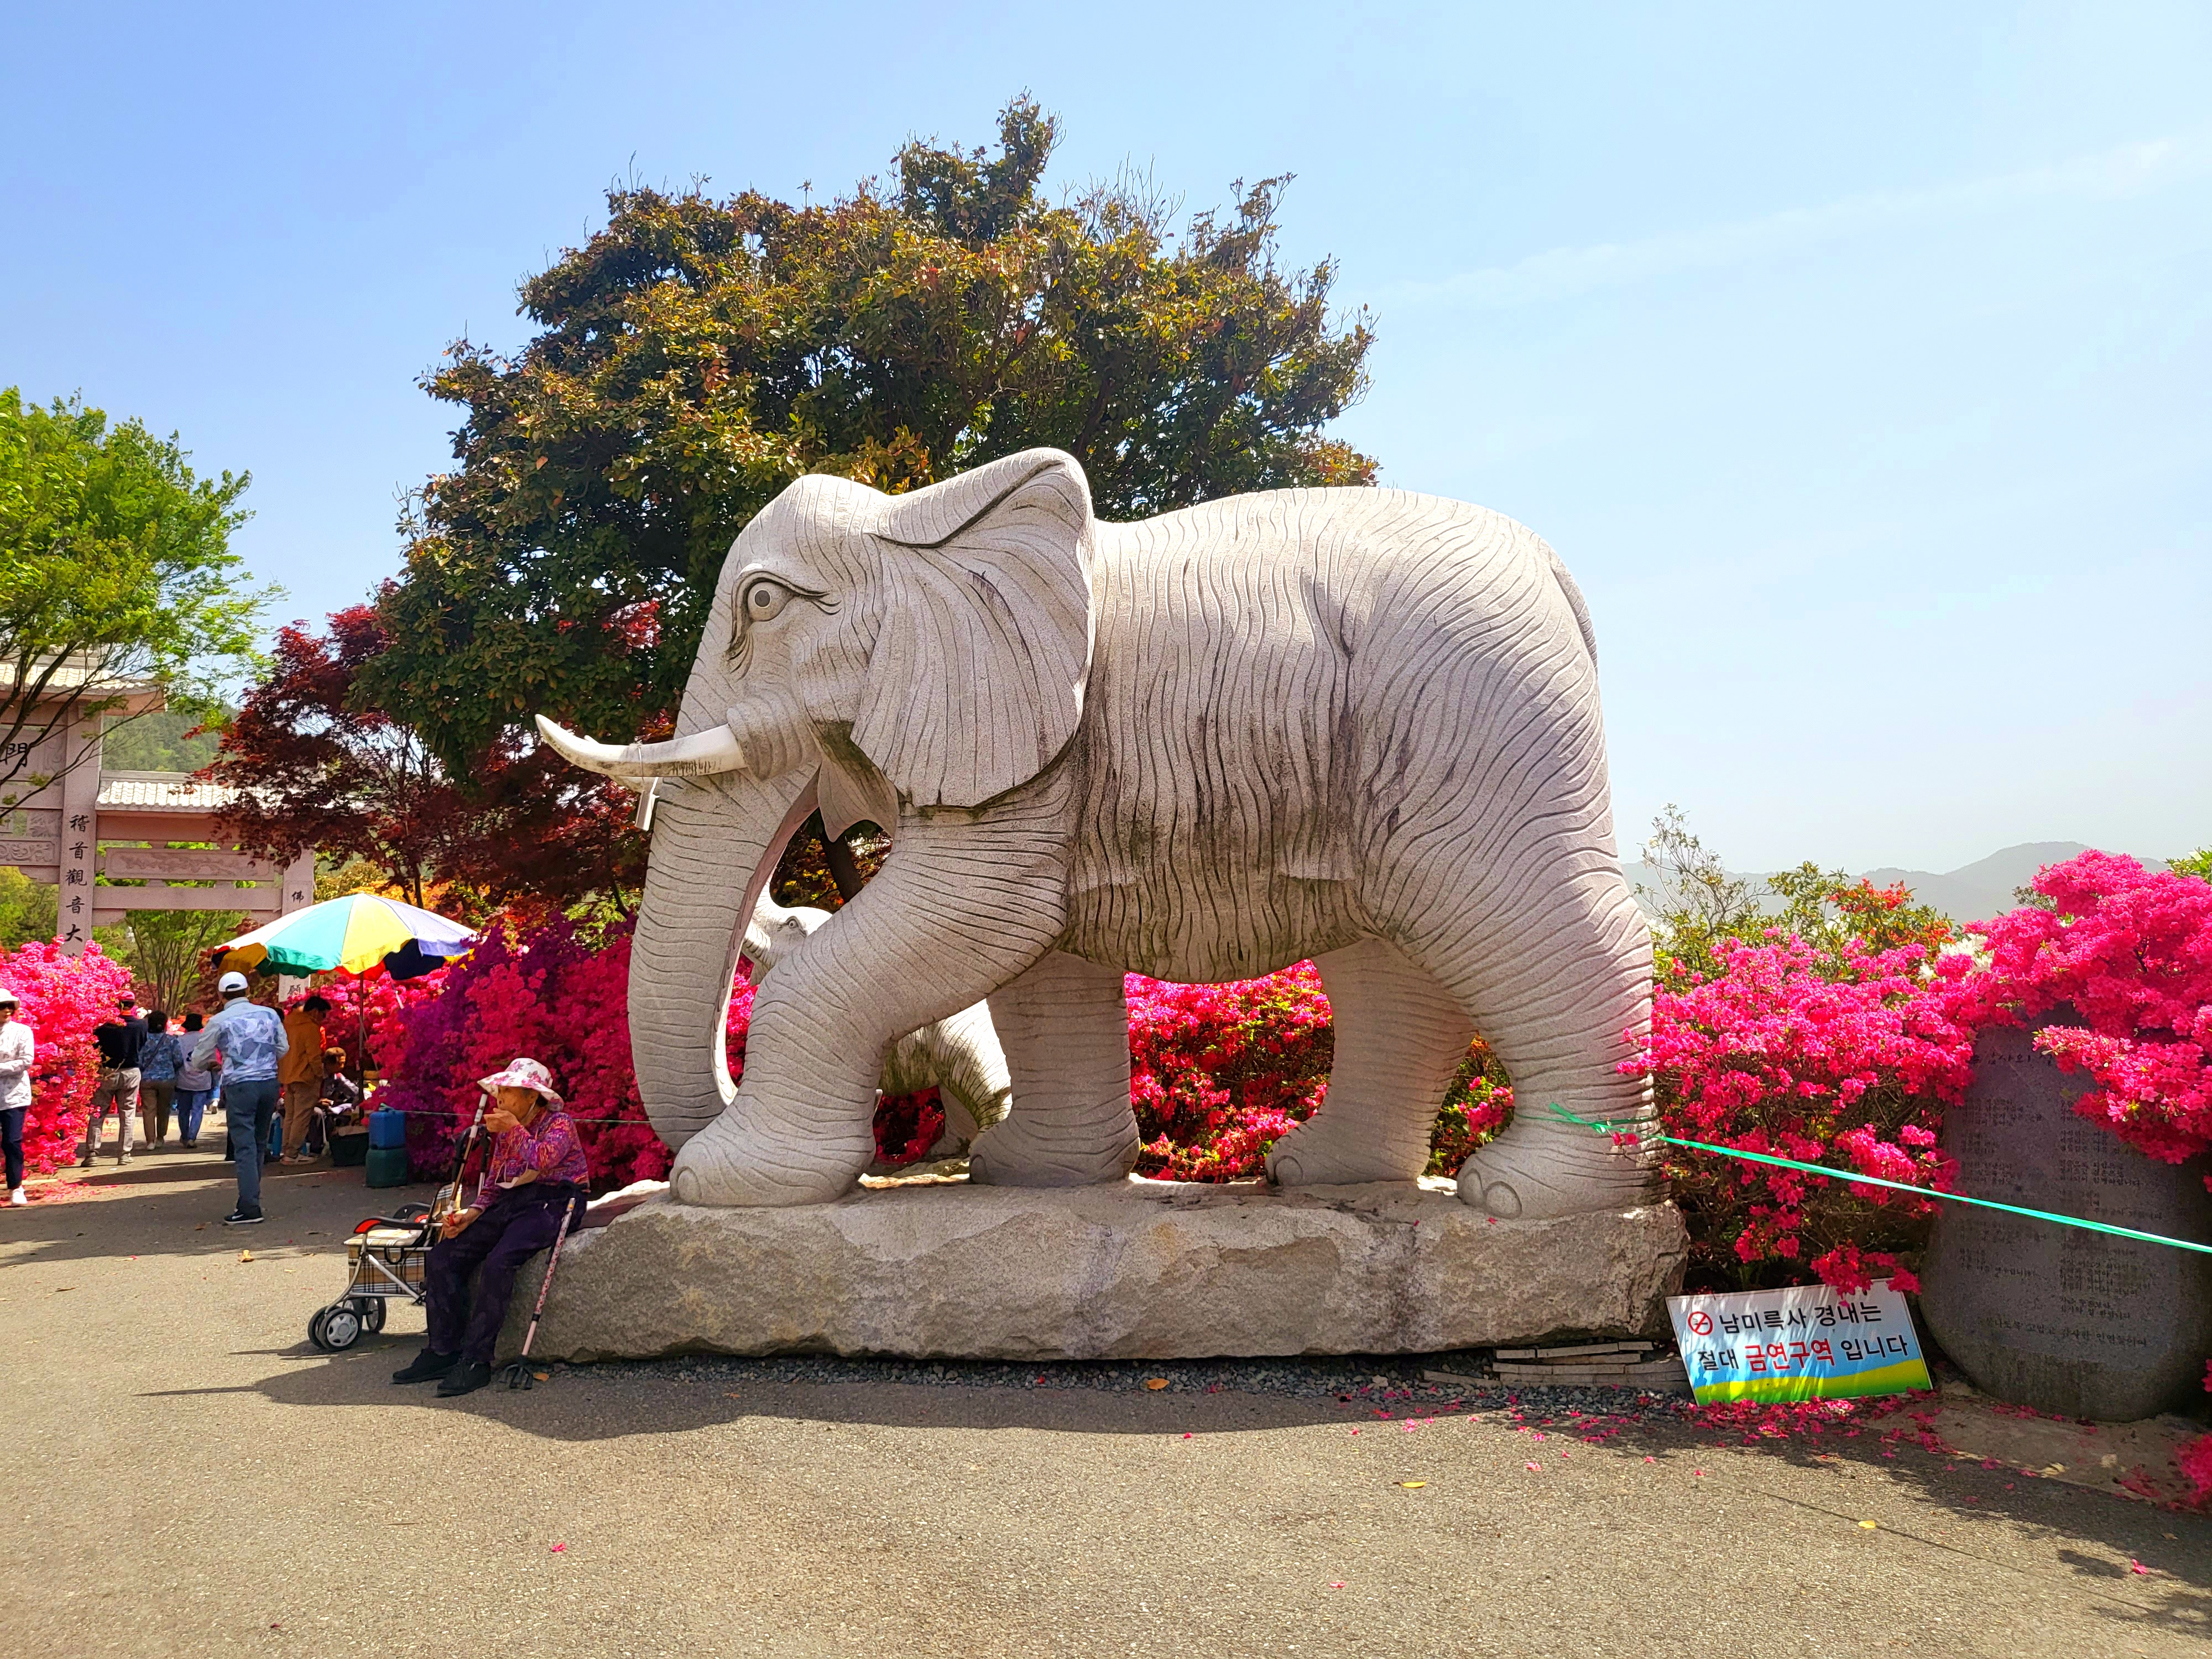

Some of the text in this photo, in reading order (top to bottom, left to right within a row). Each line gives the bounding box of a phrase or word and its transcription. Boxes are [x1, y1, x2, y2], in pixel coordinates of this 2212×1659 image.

[6, 742, 28, 768] 門
[65, 814, 90, 958] 稽首觀音大
[1719, 1302, 1881, 1334] 남미륵사 경내는
[1697, 1334, 1908, 1372] 절대 금연구역 입니다
